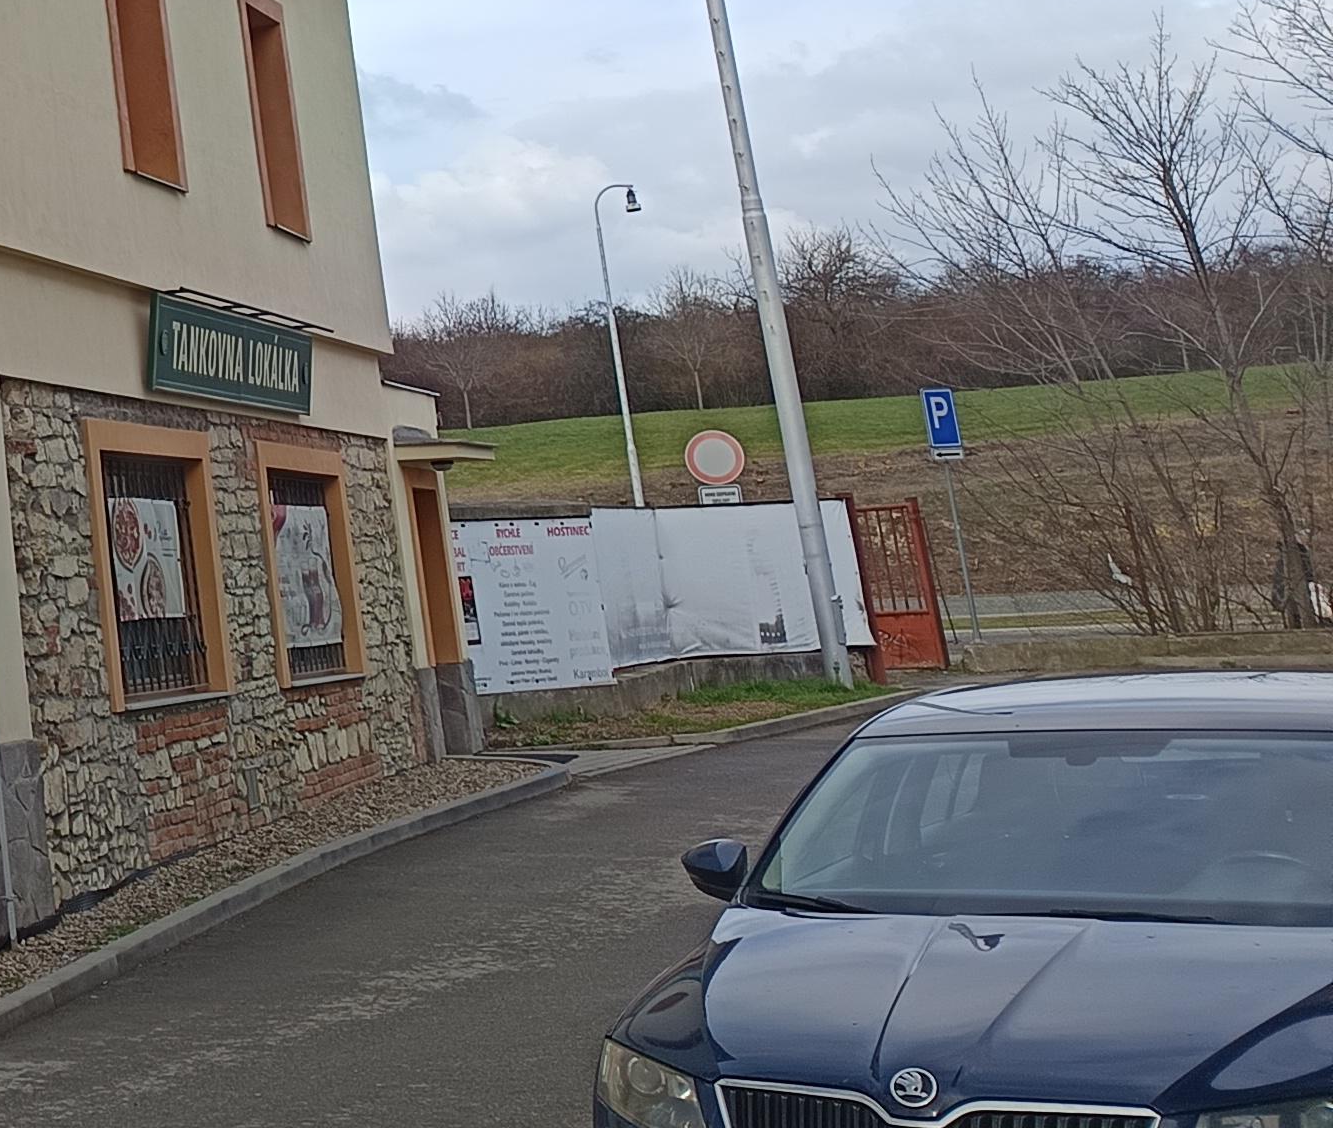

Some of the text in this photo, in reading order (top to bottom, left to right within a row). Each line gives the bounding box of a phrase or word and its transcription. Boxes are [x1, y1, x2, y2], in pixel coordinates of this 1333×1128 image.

[172, 321, 300, 393] TANKOVNA LOKÁLKA
[929, 396, 949, 429] P
[496, 527, 521, 539] RYCHLÉ
[546, 525, 590, 537] HOSTINEC
